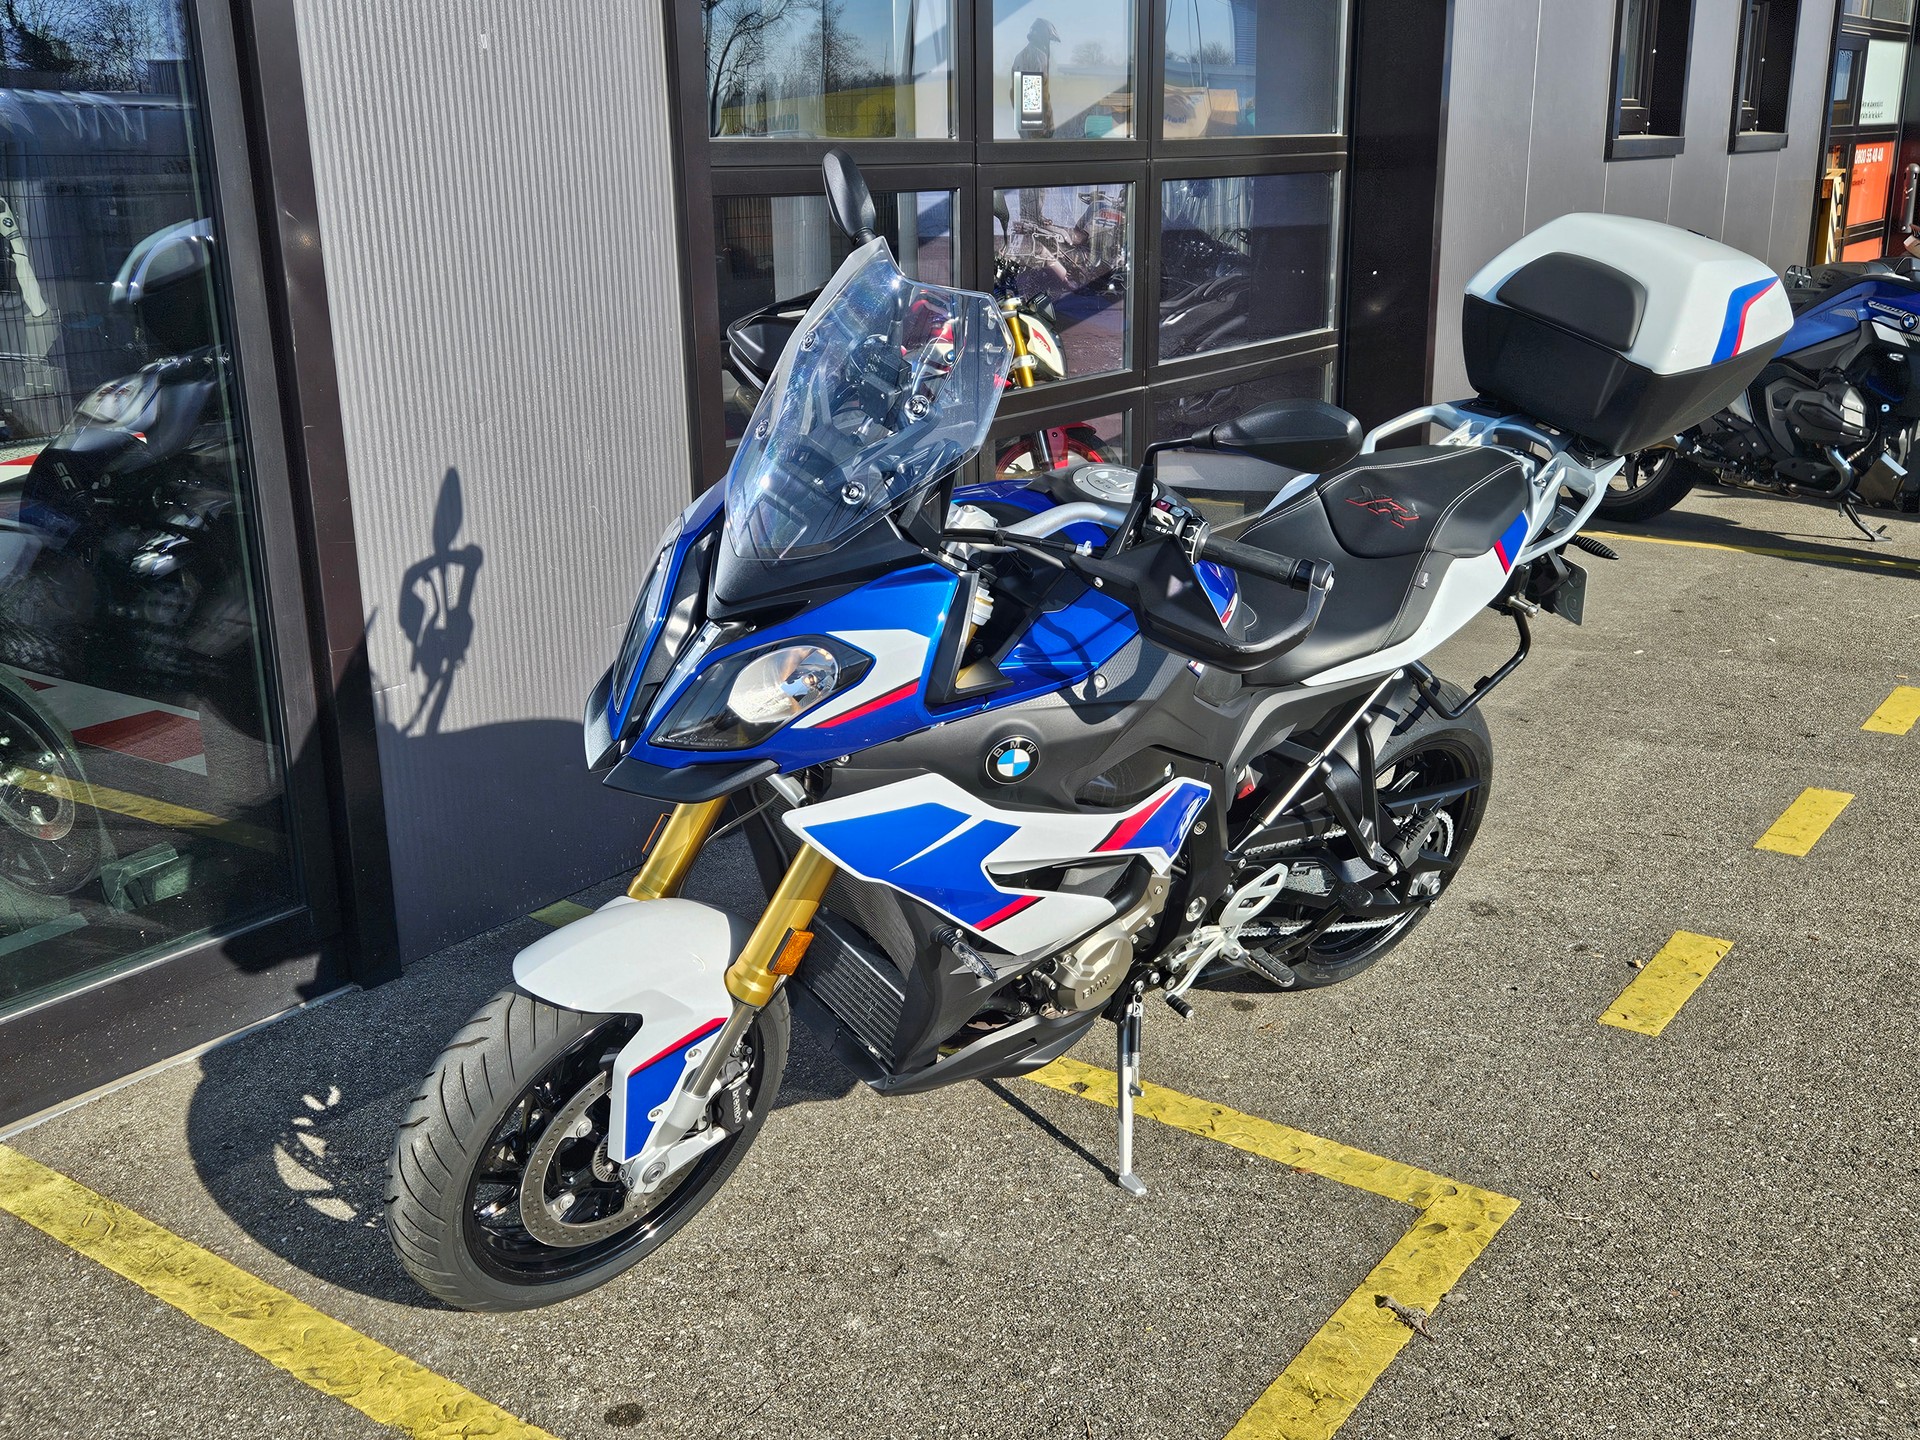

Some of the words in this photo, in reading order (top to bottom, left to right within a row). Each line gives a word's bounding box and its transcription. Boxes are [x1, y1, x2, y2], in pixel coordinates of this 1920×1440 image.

[992, 740, 1037, 758] BMW
[1082, 973, 1111, 1000] BMW
[732, 1087, 744, 1124] brembo
